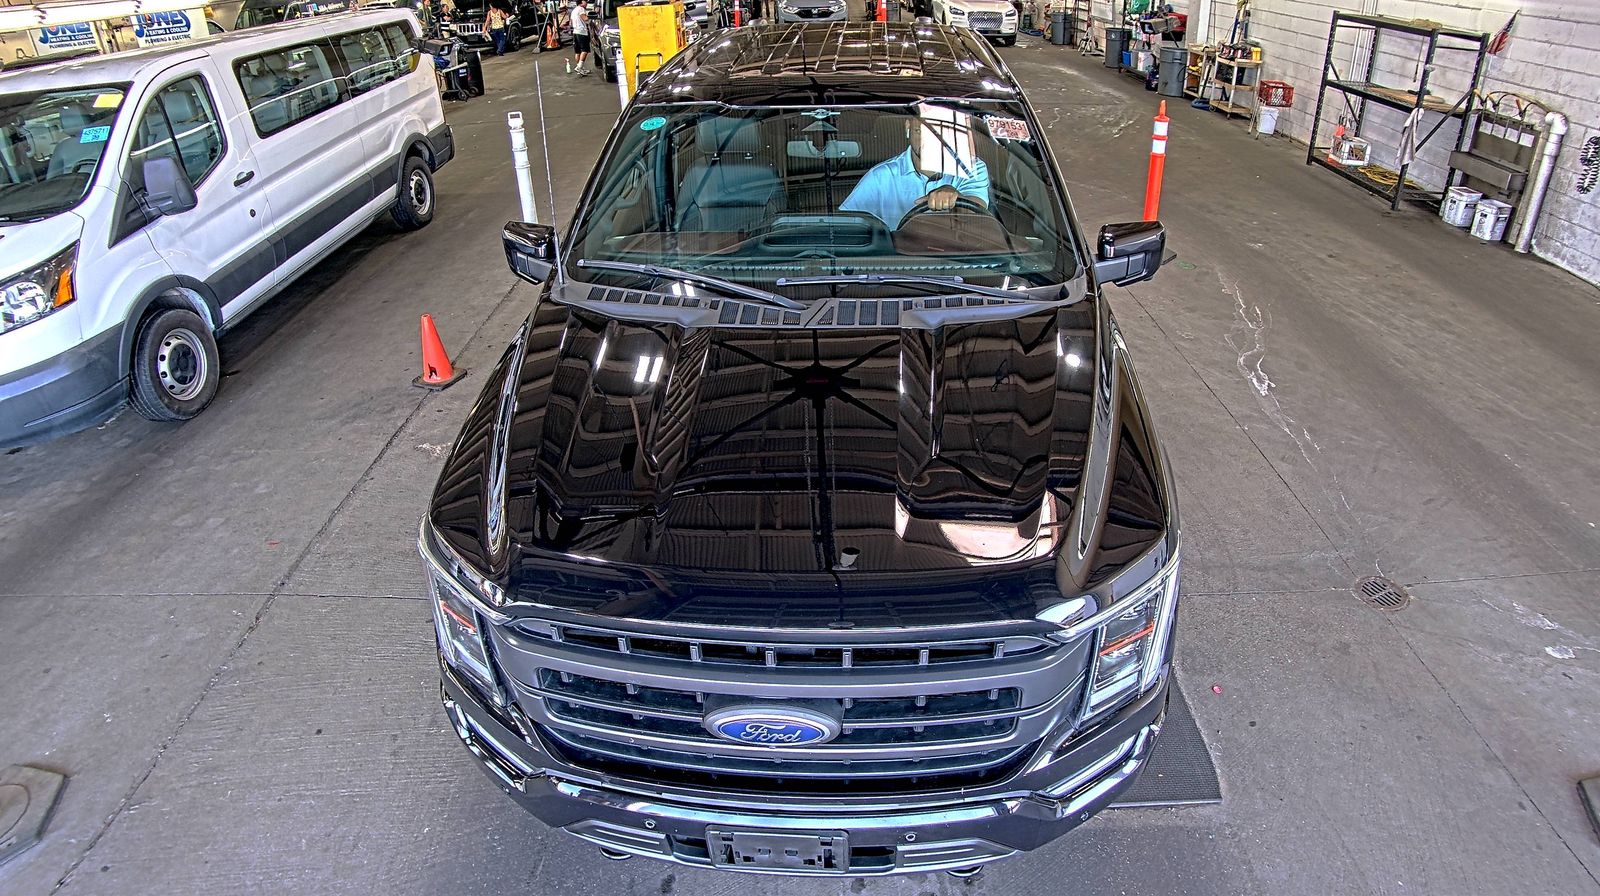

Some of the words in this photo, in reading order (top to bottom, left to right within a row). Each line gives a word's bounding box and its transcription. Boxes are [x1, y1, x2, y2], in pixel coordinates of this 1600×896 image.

[135, 9, 191, 38] JONES
[170, 26, 188, 34] COOLING
[50, 35, 71, 43] HEATING
[172, 33, 191, 41] ELECTRIC
[988, 119, 1027, 131] 9791531
[740, 723, 802, 742] Ford
